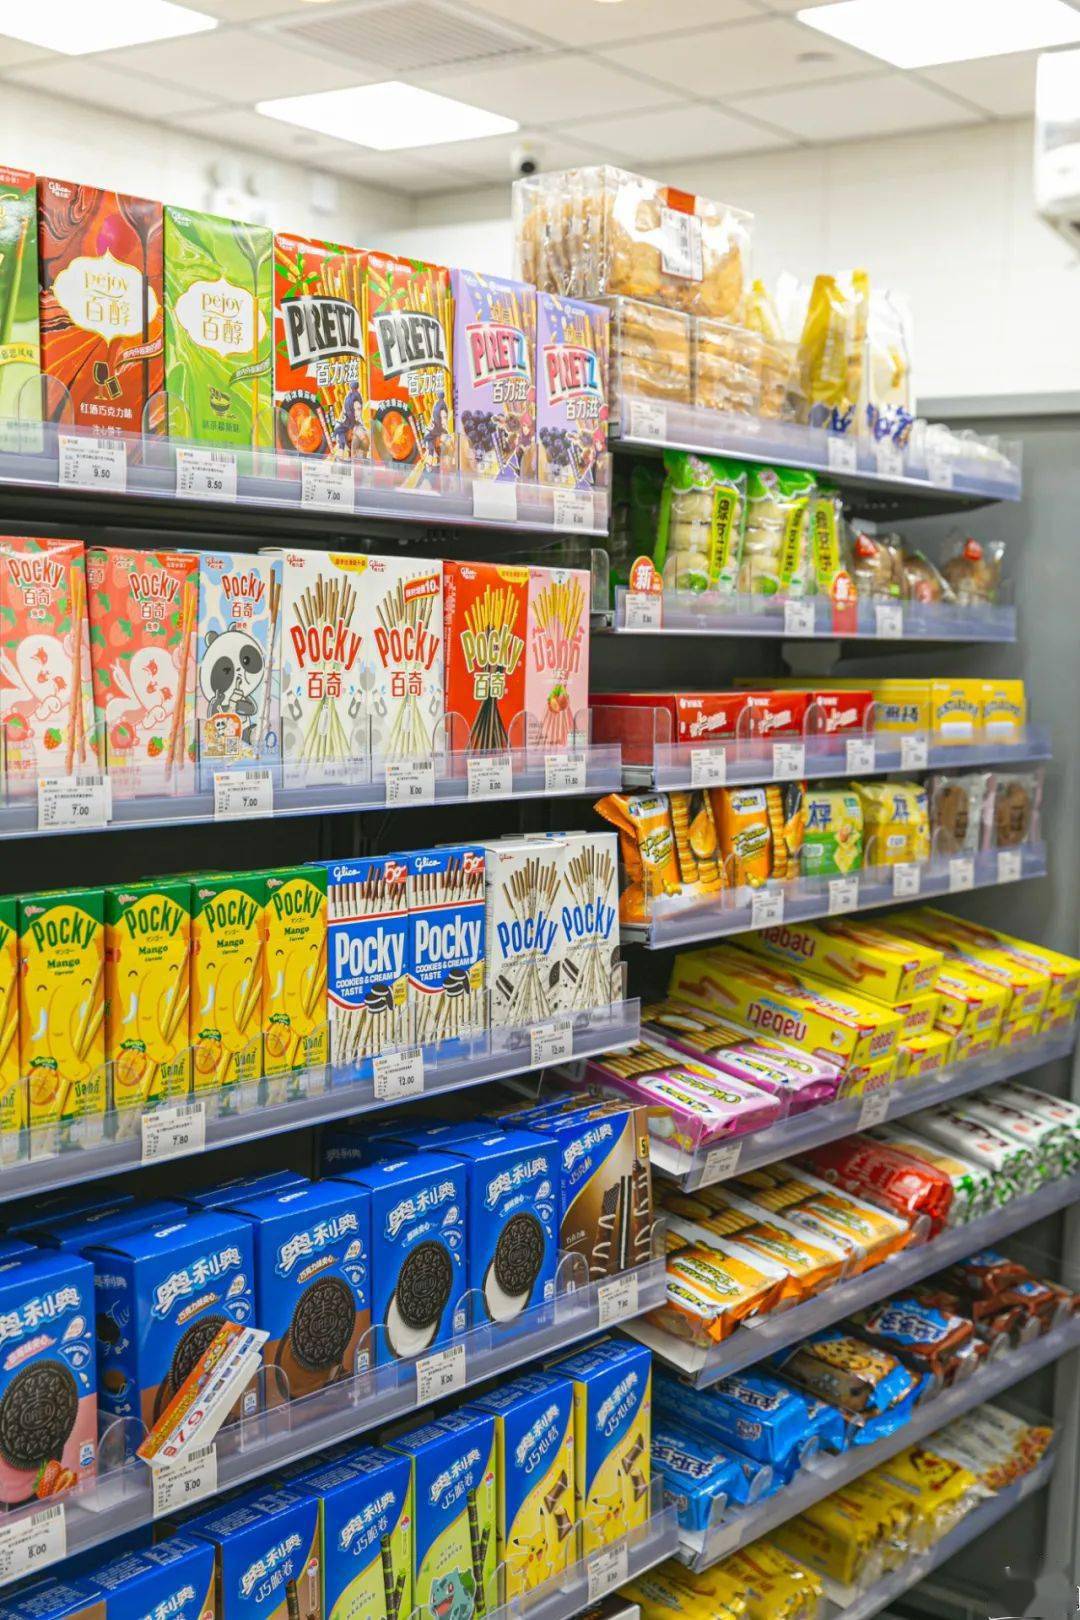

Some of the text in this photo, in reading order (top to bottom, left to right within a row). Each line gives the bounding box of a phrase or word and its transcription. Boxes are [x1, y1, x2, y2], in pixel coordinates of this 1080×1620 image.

[202, 317, 243, 345] 百醇
[287, 301, 360, 356] PRETZ
[379, 318, 444, 369] PRETZ
[470, 325, 527, 375] PRETZ
[316, 361, 359, 387] 百力滋
[407, 373, 445, 396] 百力滋
[546, 349, 598, 396] PRETZ
[493, 380, 527, 403] 百力滋
[566, 400, 599, 420] 百力滋
[94, 468, 110, 479] 9.50
[207, 479, 222, 490] 8.50
[327, 489, 341, 501] 7.00
[24, 588, 50, 605] 百奇
[142, 603, 165, 619] 百奇
[232, 602, 253, 618] 百奇
[308, 672, 343, 699] 百奇
[391, 671, 423, 697] 百奇
[474, 672, 505, 700] 百奇
[72, 806, 90, 816] 7.00
[243, 797, 258, 807] 7.00
[333, 866, 360, 881] Glico
[415, 856, 441, 872] Glico
[217, 936, 244, 949] Mango
[284, 924, 310, 937] Mango
[415, 914, 481, 964] Pocky
[138, 945, 169, 956] Mango
[335, 926, 405, 979] Pocky
[47, 958, 81, 970] Mango
[415, 963, 442, 974] COOKIES
[447, 958, 471, 968] CREAM
[336, 977, 364, 989] COOKIES
[369, 973, 393, 983] CREAM
[420, 972, 442, 982] TASTE
[341, 986, 363, 997] TASTE
[564, 1124, 613, 1170] 奥利奥
[487, 1157, 549, 1204] 奥利奥
[387, 1181, 456, 1236] 奥利奥
[279, 1213, 358, 1272] 奥利奥
[157, 1247, 241, 1315] 奥利奥
[597, 1371, 637, 1430] 奥利奥
[517, 1404, 559, 1466] 奥利奥
[431, 1448, 481, 1503] 奥利奥
[341, 1491, 395, 1549] 奥利奥
[241, 1534, 302, 1597] 奥利奥
